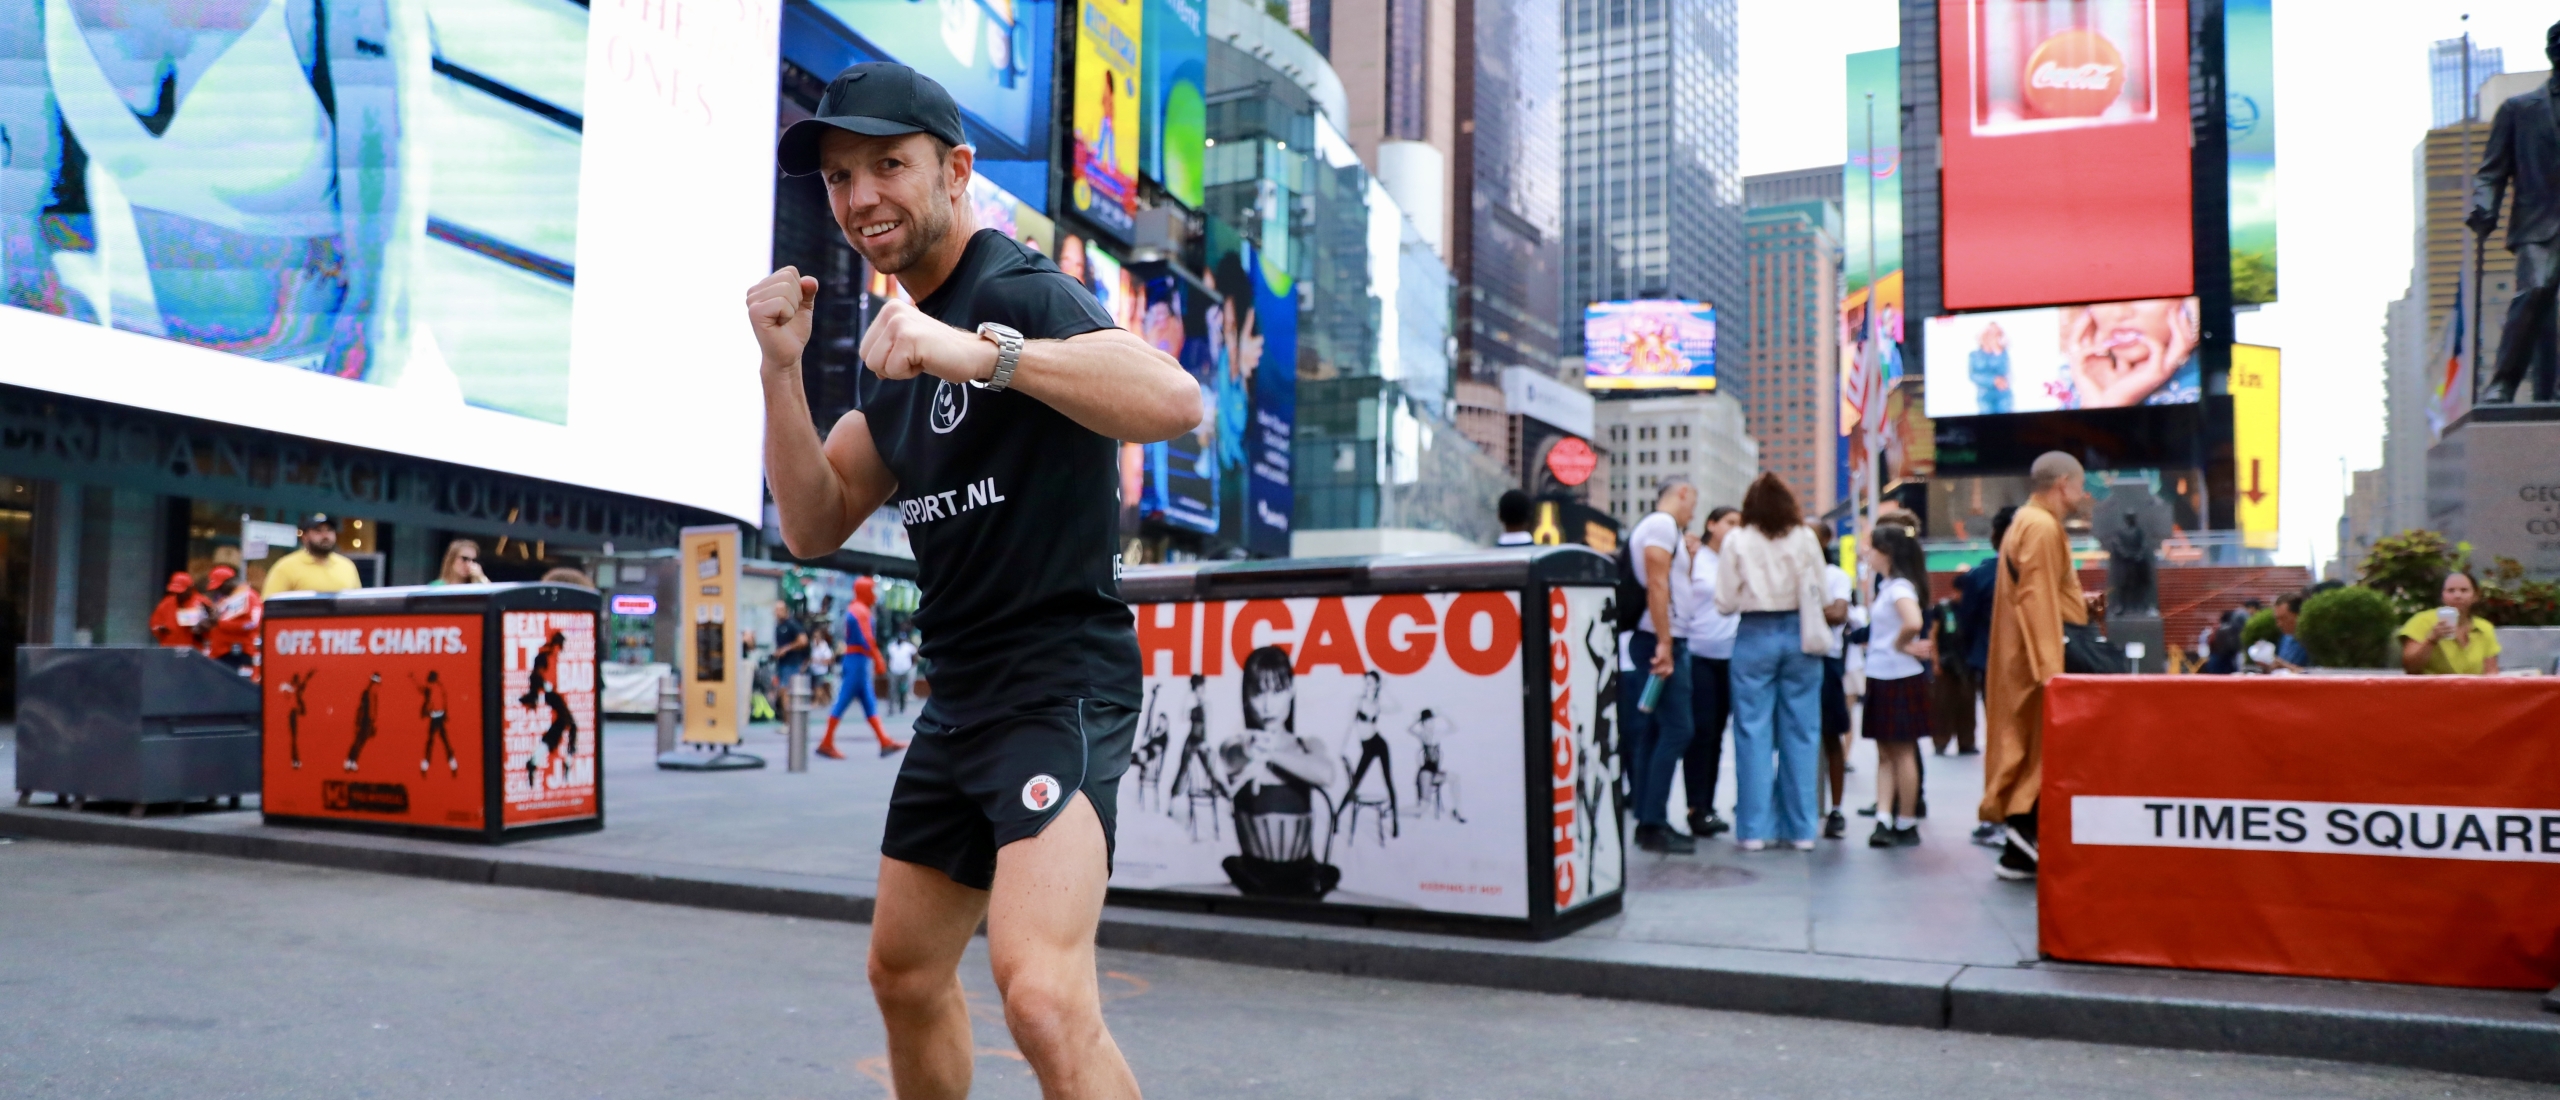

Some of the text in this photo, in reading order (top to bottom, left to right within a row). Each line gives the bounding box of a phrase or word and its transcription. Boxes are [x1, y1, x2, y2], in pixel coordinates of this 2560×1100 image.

[275, 626, 467, 655] OFF. THE. CHARTS.
[503, 612, 547, 637] BEAT
[503, 637, 547, 671] IT
[556, 661, 595, 693] BAD
[1549, 587, 1574, 907] CHICAGO
[2144, 803, 2560, 854] TIMES SQUARE
